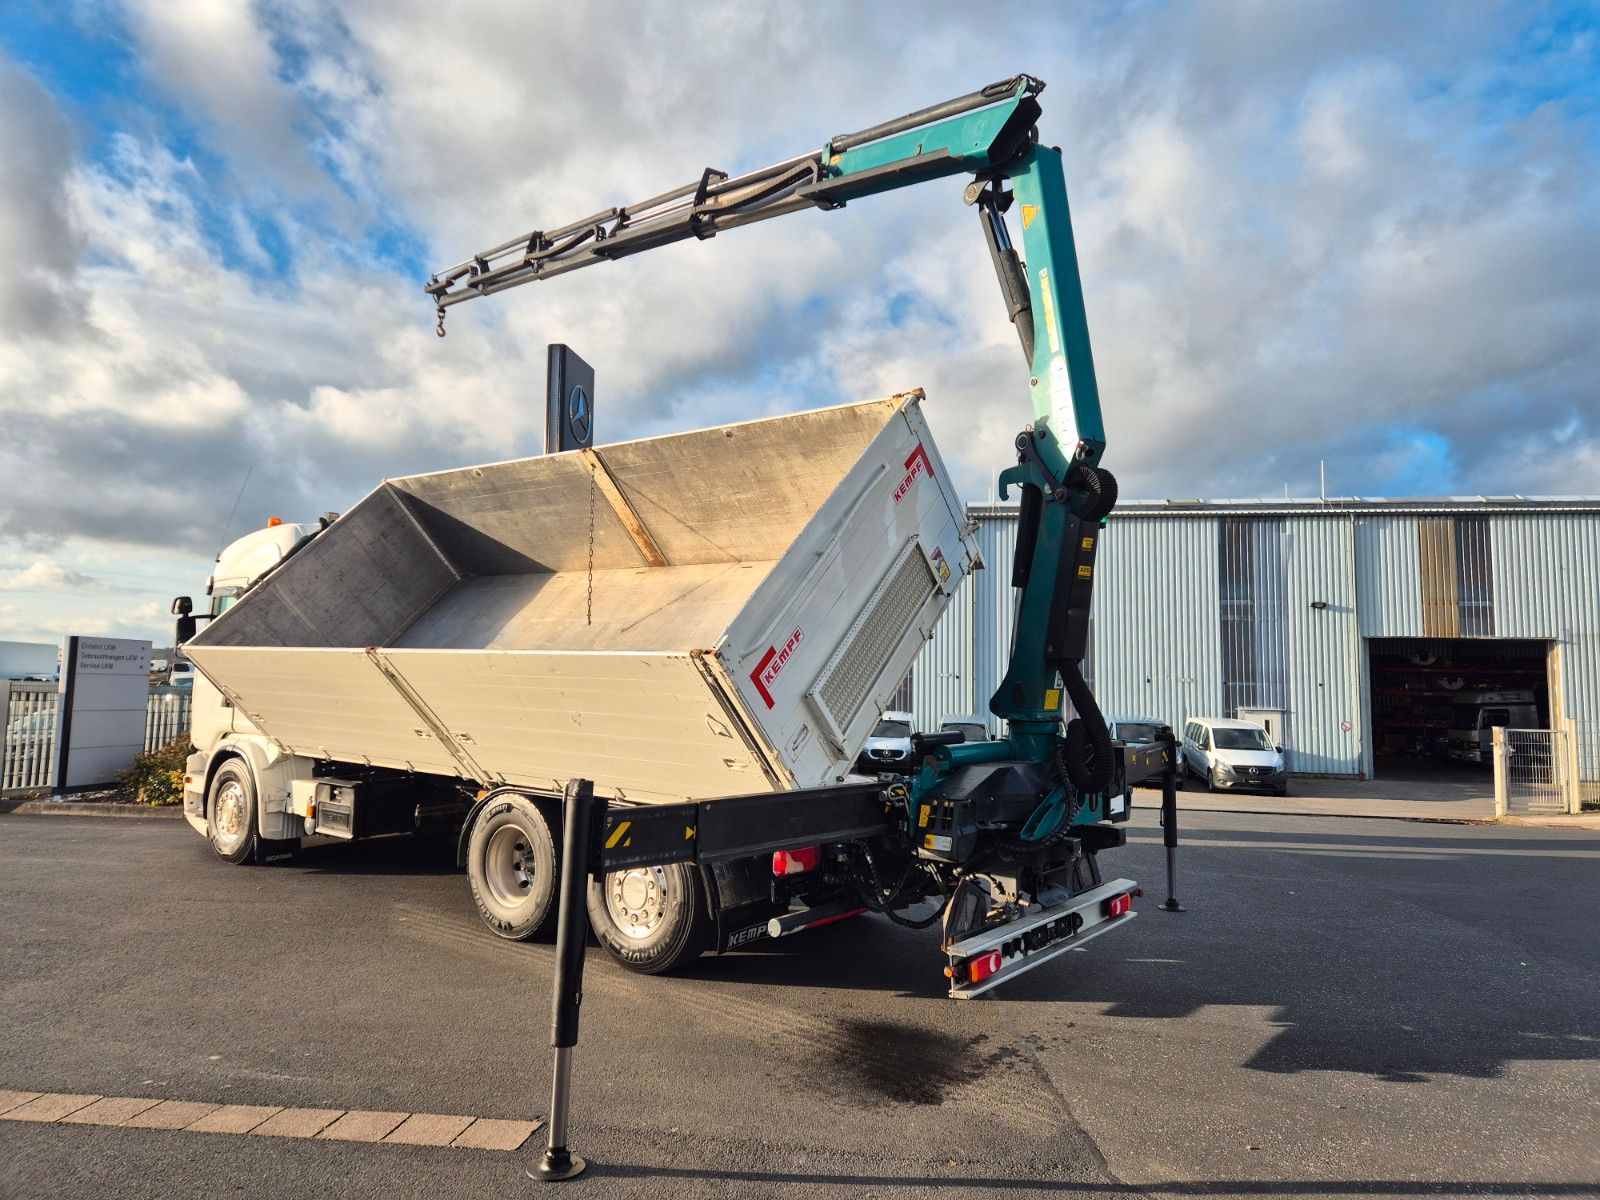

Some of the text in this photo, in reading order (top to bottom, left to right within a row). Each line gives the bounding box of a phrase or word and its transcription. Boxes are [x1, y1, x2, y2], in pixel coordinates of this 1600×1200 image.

[893, 460, 922, 502] KEMPF
[763, 628, 802, 684] KEMPF
[728, 925, 769, 948] KEMP
